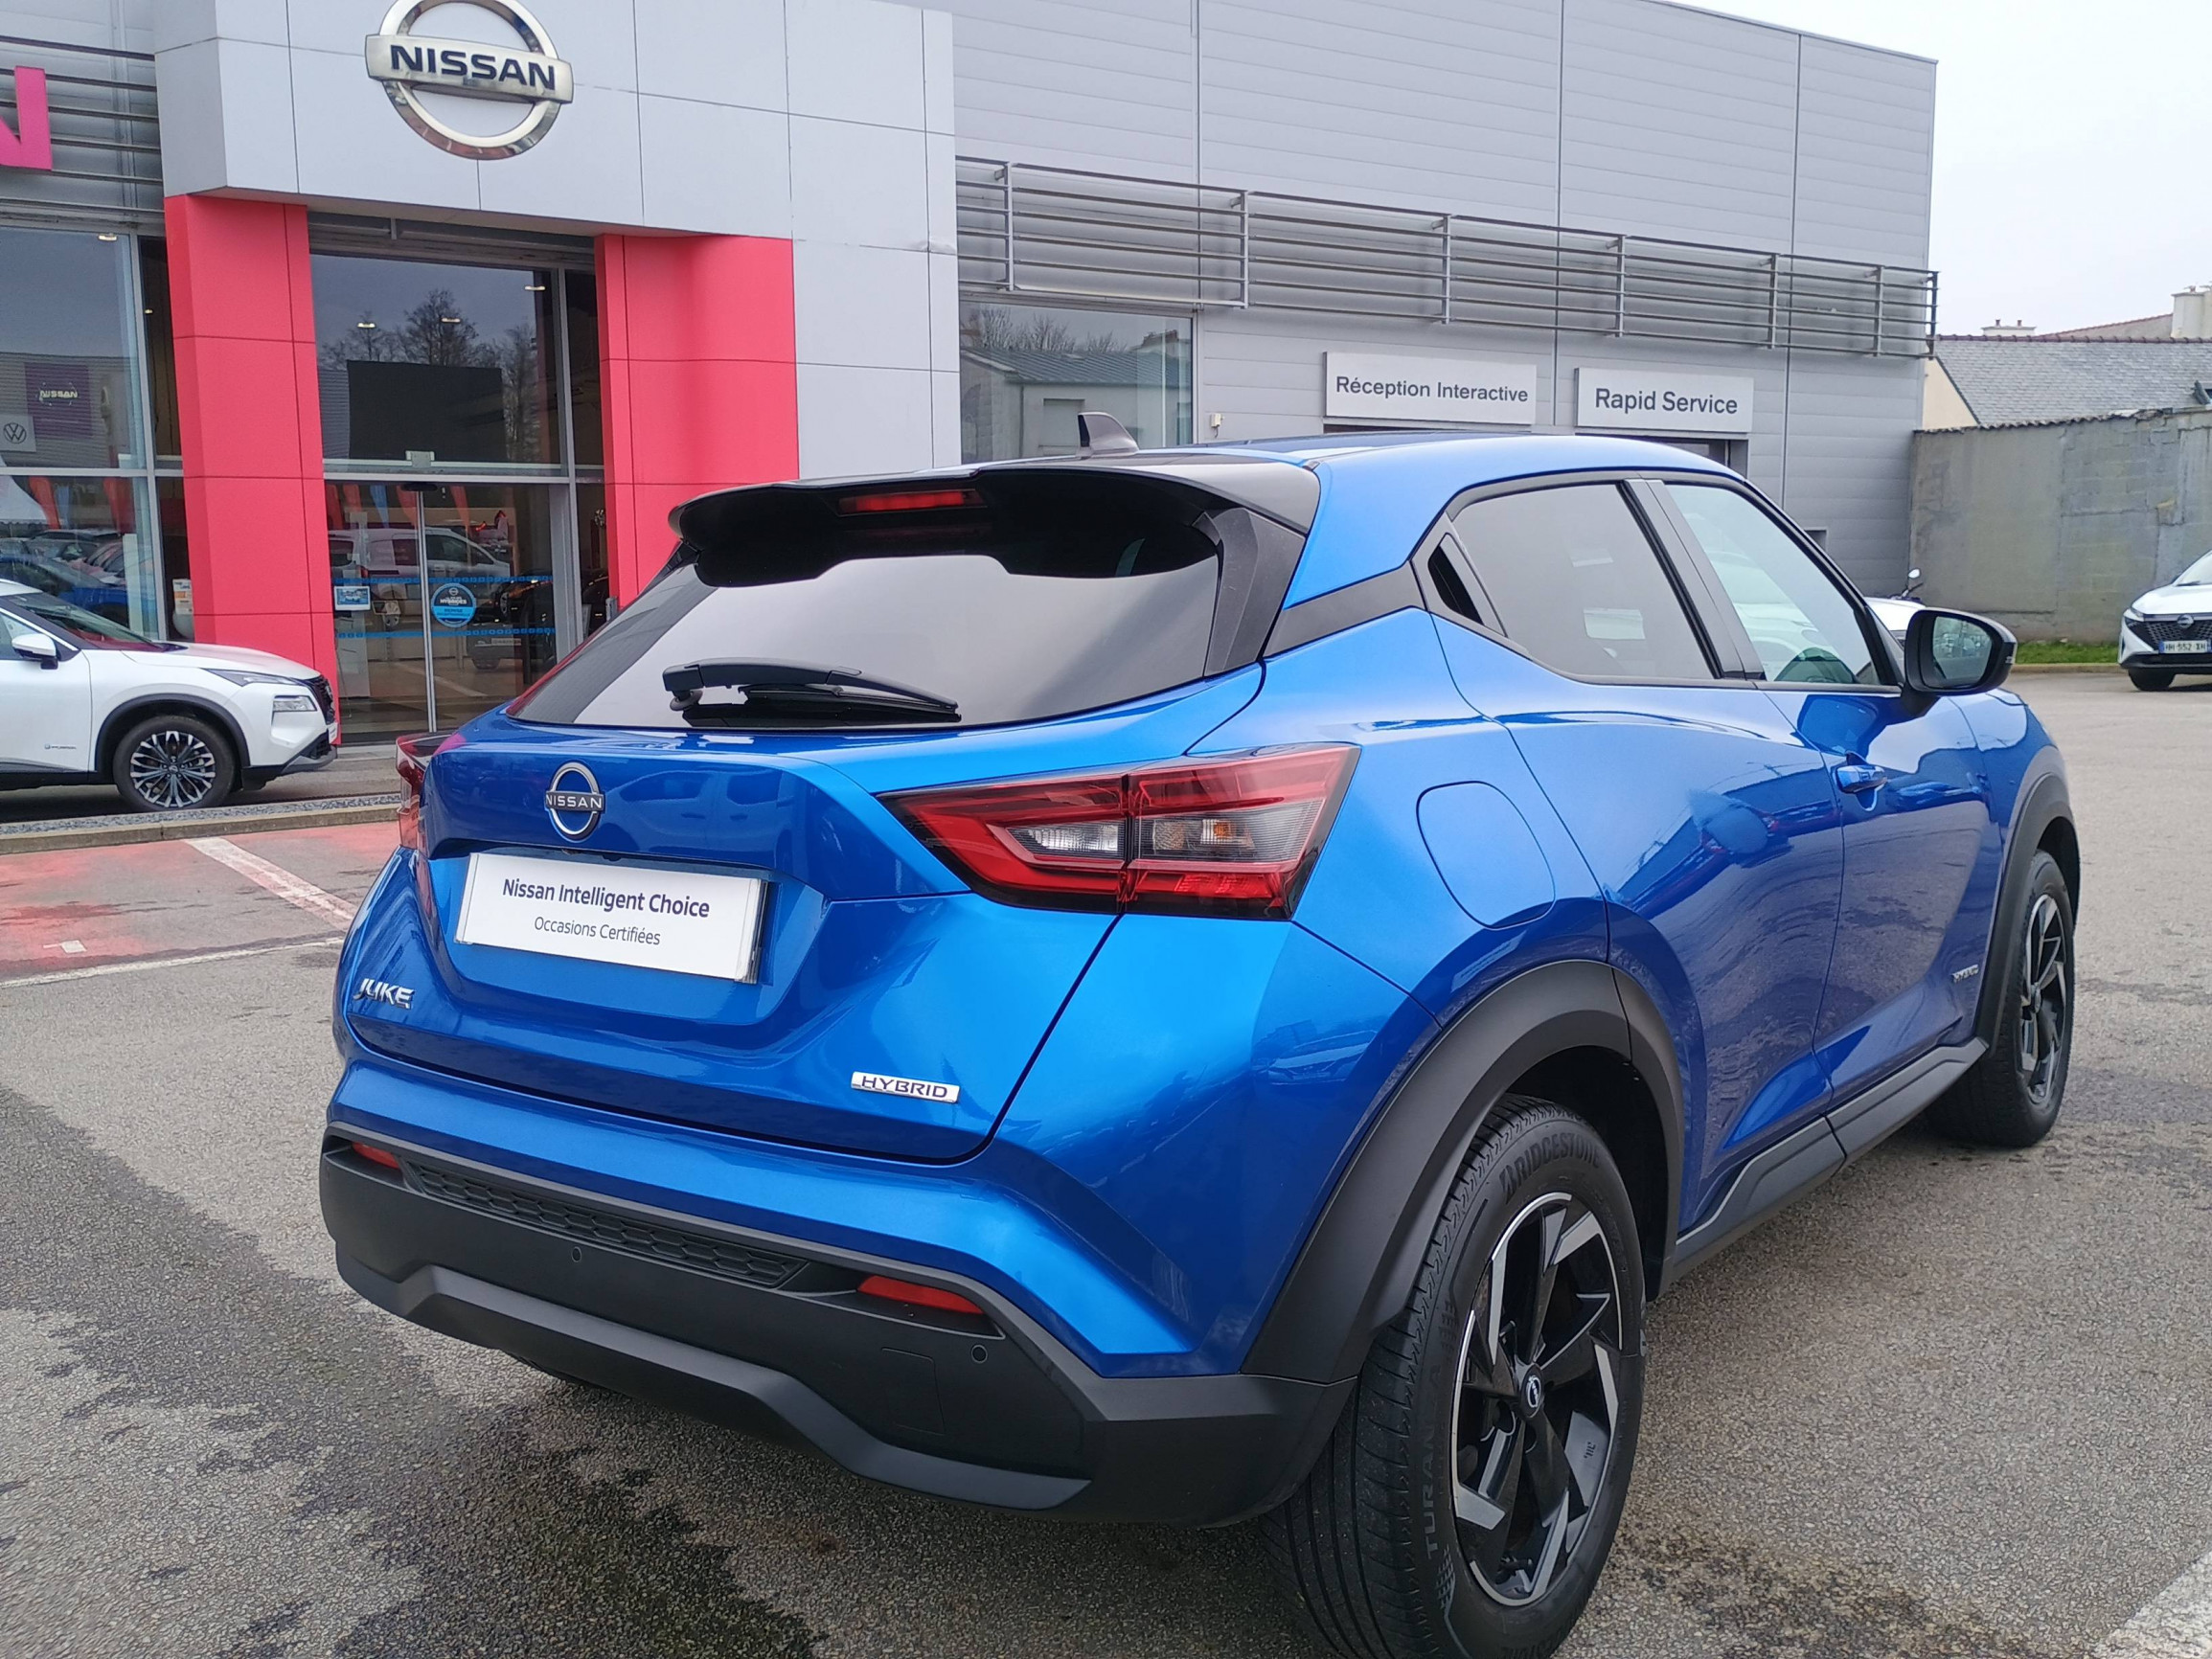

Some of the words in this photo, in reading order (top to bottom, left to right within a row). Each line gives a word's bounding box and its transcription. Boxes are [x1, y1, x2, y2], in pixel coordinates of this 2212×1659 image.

[390, 44, 556, 91] NISSAN
[39, 390, 78, 398] NISSAN
[1335, 375, 1430, 398] Réception
[1437, 381, 1528, 402] Interactive
[1595, 387, 1656, 414] Rapid
[1661, 391, 1738, 414] Service
[545, 794, 602, 808] NISSAN
[502, 878, 555, 901] Nissan
[559, 884, 645, 912] Intelligent
[649, 894, 710, 918] Choice
[535, 917, 597, 937] Occasions
[599, 924, 661, 945] Certifiées
[353, 978, 414, 1009] JUKE
[861, 1076, 947, 1098] HYBRID
